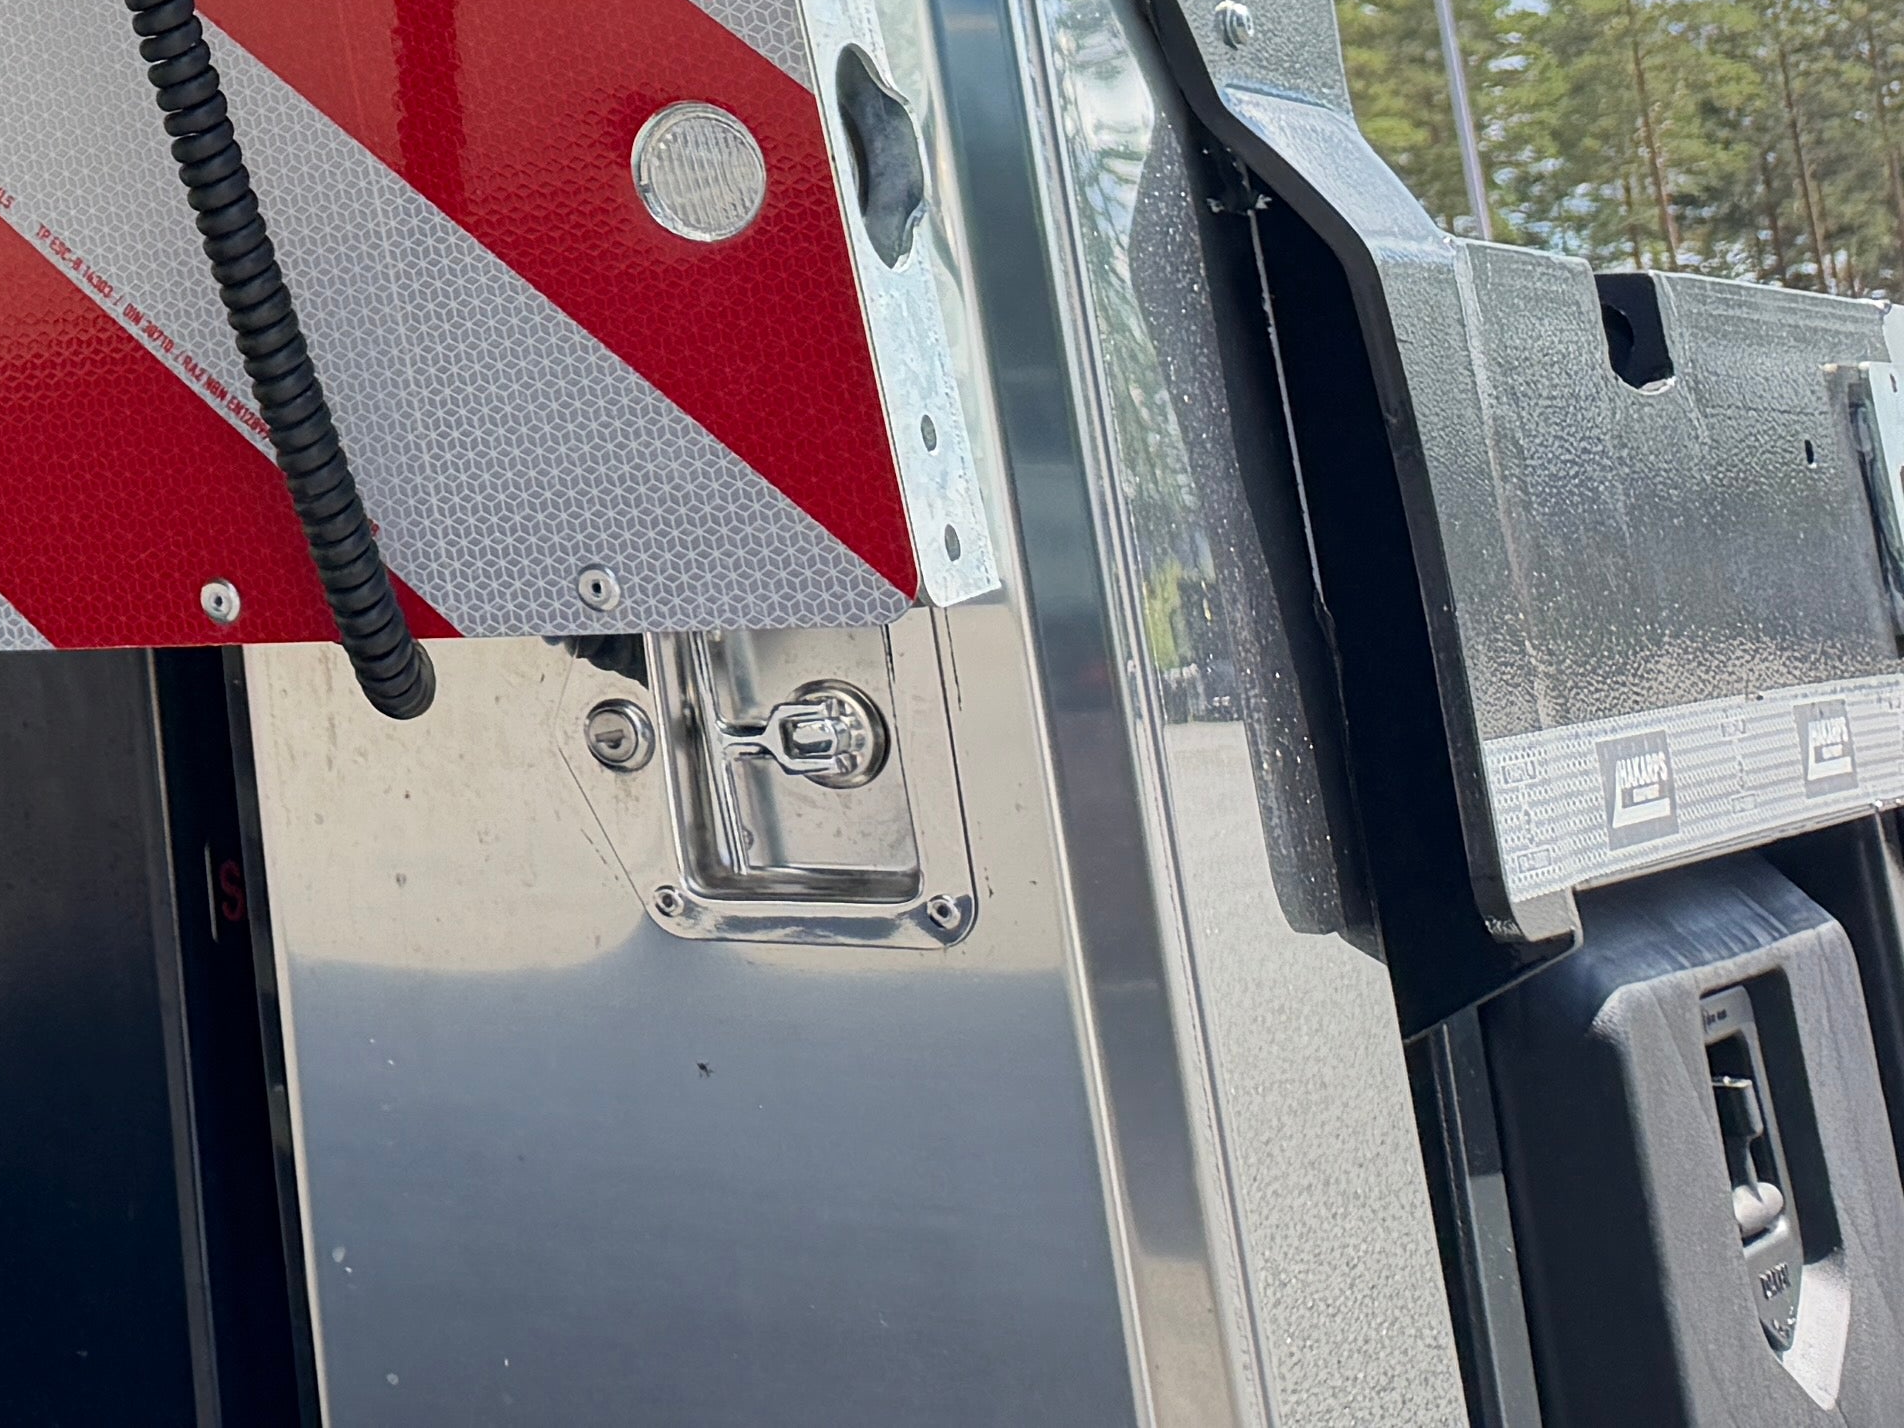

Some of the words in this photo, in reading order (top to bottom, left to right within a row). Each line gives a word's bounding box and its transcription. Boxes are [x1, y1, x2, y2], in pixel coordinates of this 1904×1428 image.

[36, 223, 52, 240] TP
[48, 236, 85, 270] ESC-B
[122, 302, 145, 327] DIN
[181, 354, 207, 382] RA2
[1617, 750, 1669, 788] HAKARPS
